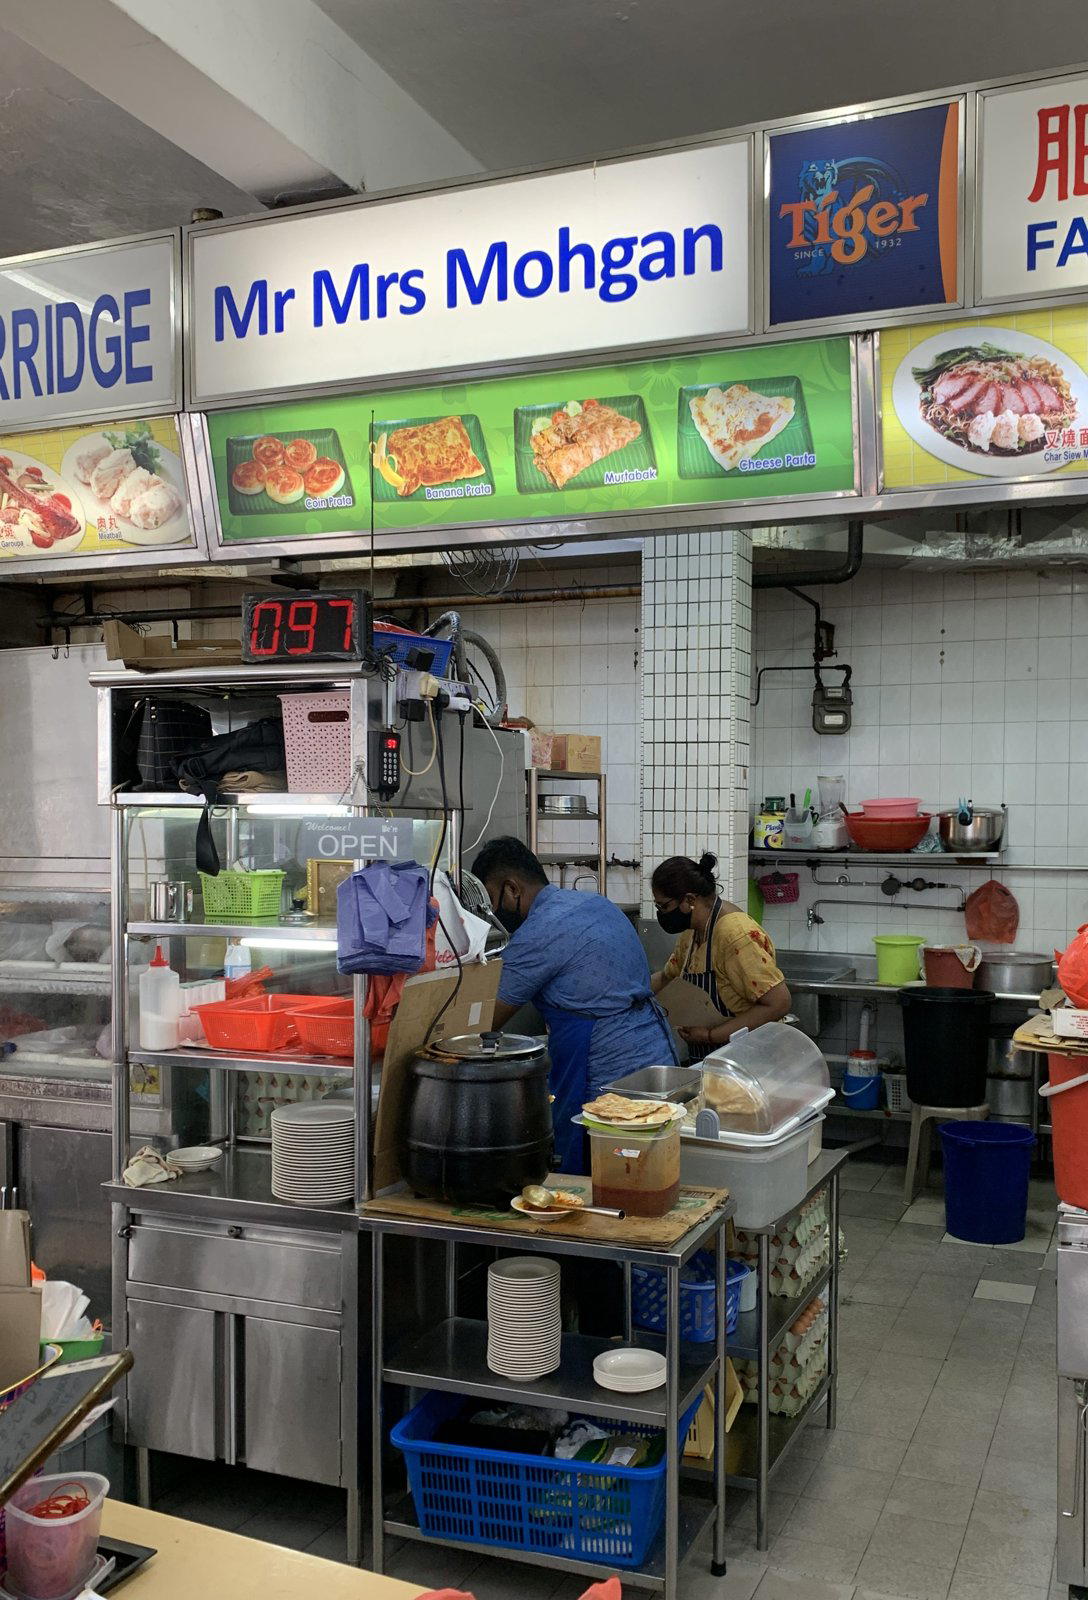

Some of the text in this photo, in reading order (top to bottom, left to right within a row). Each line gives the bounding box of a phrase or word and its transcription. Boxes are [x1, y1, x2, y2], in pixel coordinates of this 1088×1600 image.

[778, 184, 929, 265] Tiger
[794, 237, 902, 260] SINCE 1932
[1026, 216, 1088, 272] FA
[213, 223, 724, 342] Mr Mrs Mohgan
[740, 453, 816, 471] Cheese Parta
[1044, 452, 1062, 462] Char
[1063, 450, 1082, 460] Siew
[604, 469, 657, 483] Murtabak
[426, 484, 492, 499] Banana Prata
[305, 496, 353, 509] Coin Prata
[97, 515, 119, 529] 肉丸
[250, 600, 354, 655] 097
[318, 834, 398, 857] OPEN
